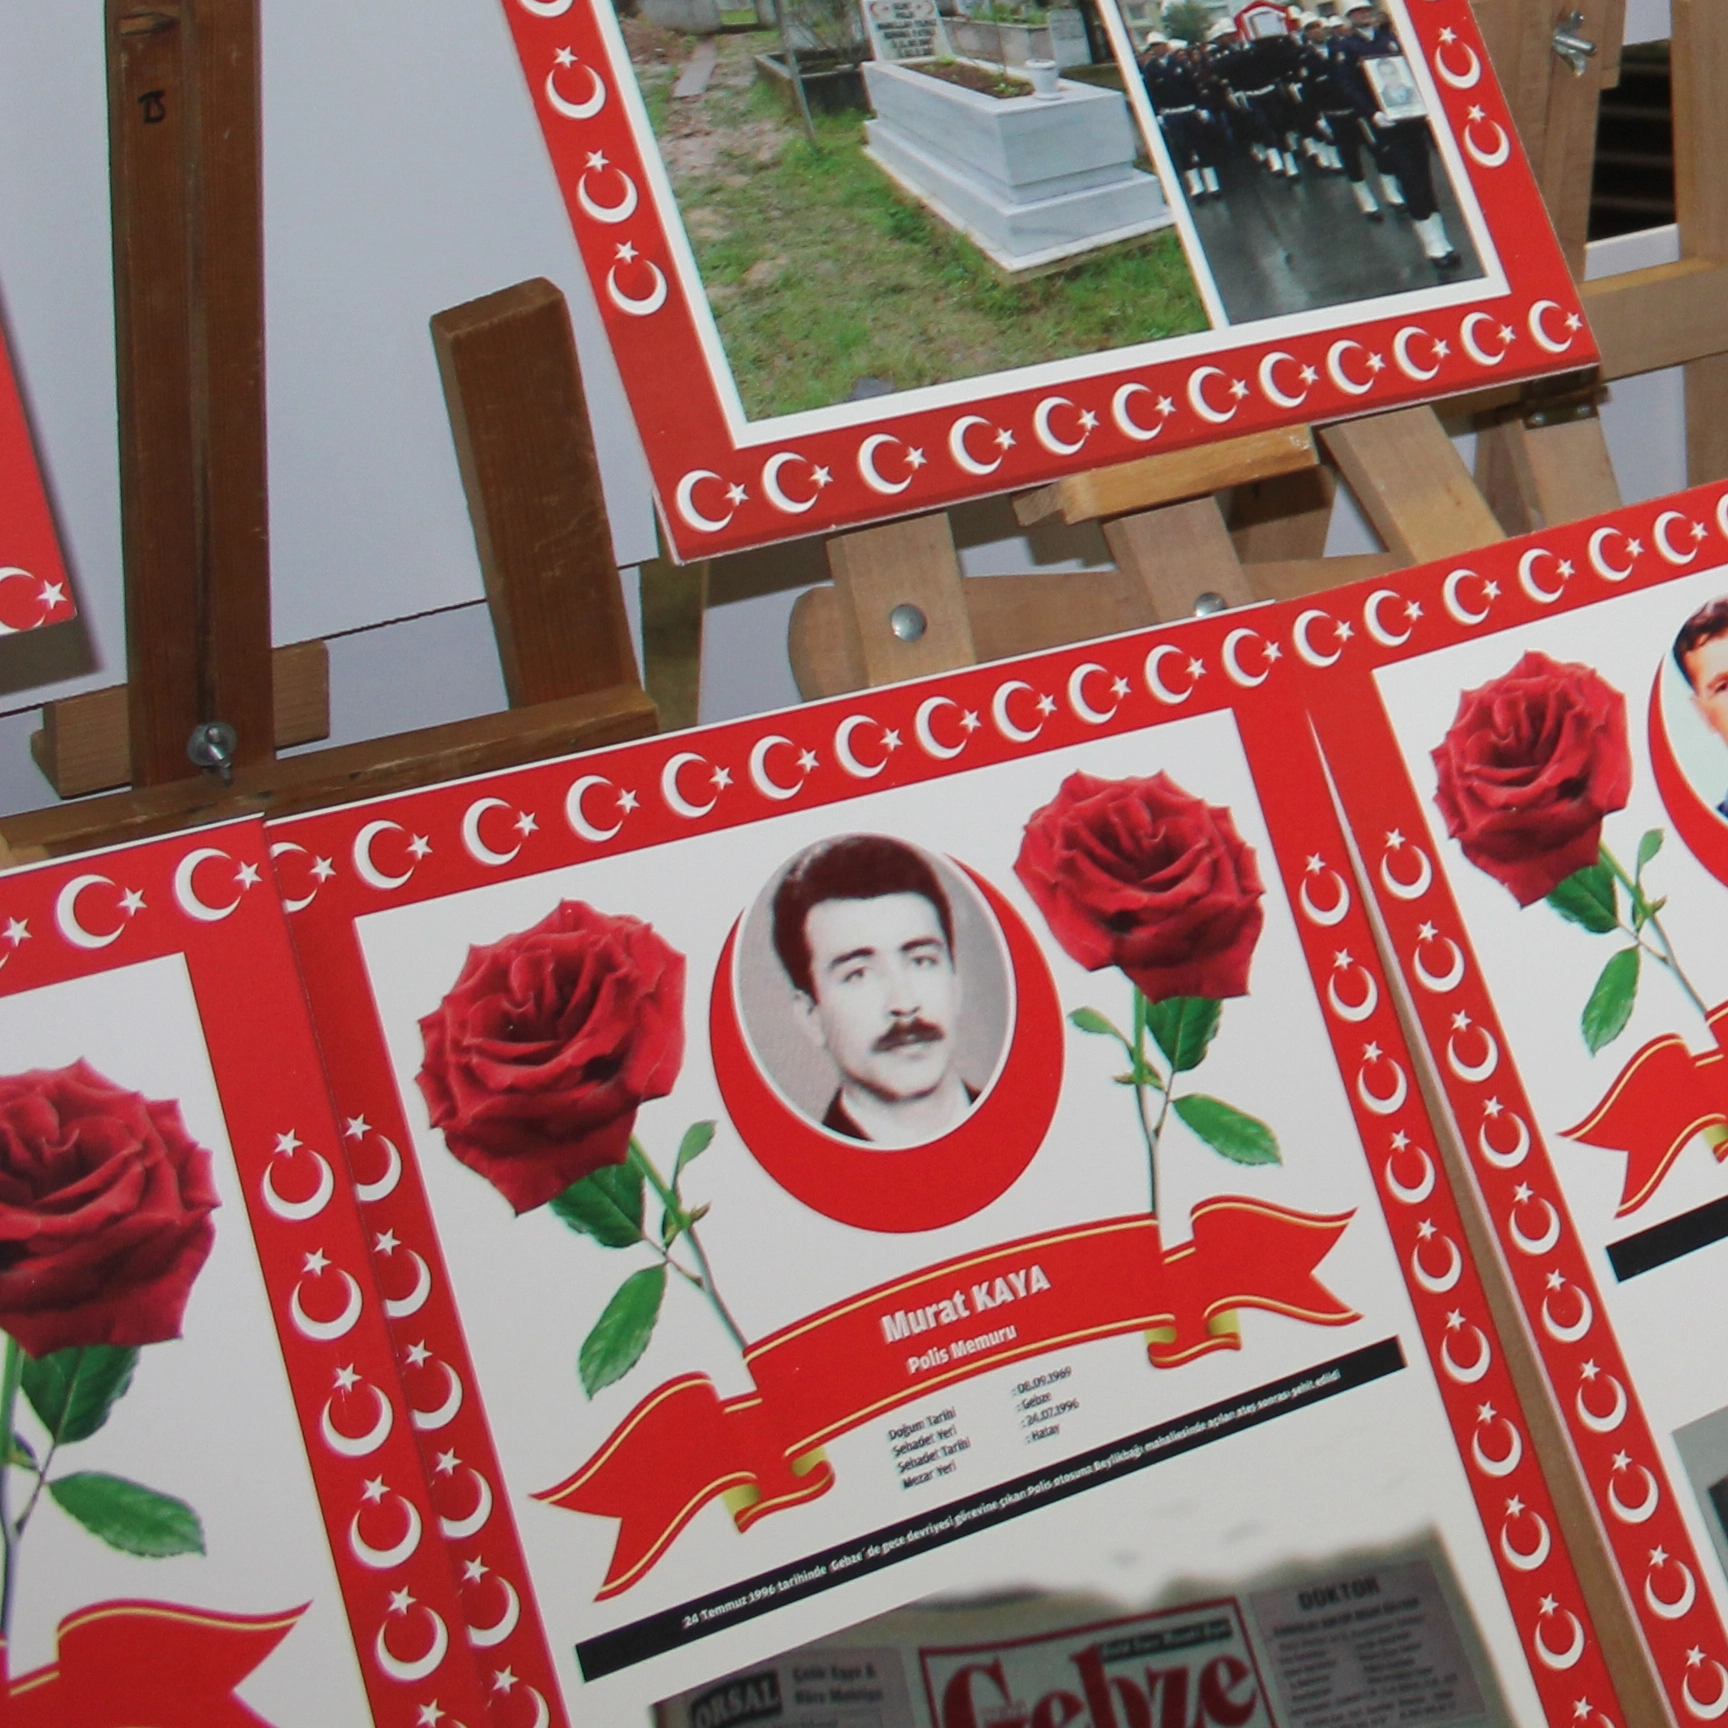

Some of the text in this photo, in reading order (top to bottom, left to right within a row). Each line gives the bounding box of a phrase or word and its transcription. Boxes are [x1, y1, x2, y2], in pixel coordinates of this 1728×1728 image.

[881, 1264, 1051, 1343] Murat KAYA
[907, 1325, 1018, 1375] Polis Memuru
[926, 1405, 957, 1426] Tarihi
[941, 1436, 971, 1457] Tarihi
[698, 1593, 748, 1621] Temmuz
[746, 1582, 777, 1603] 1996
